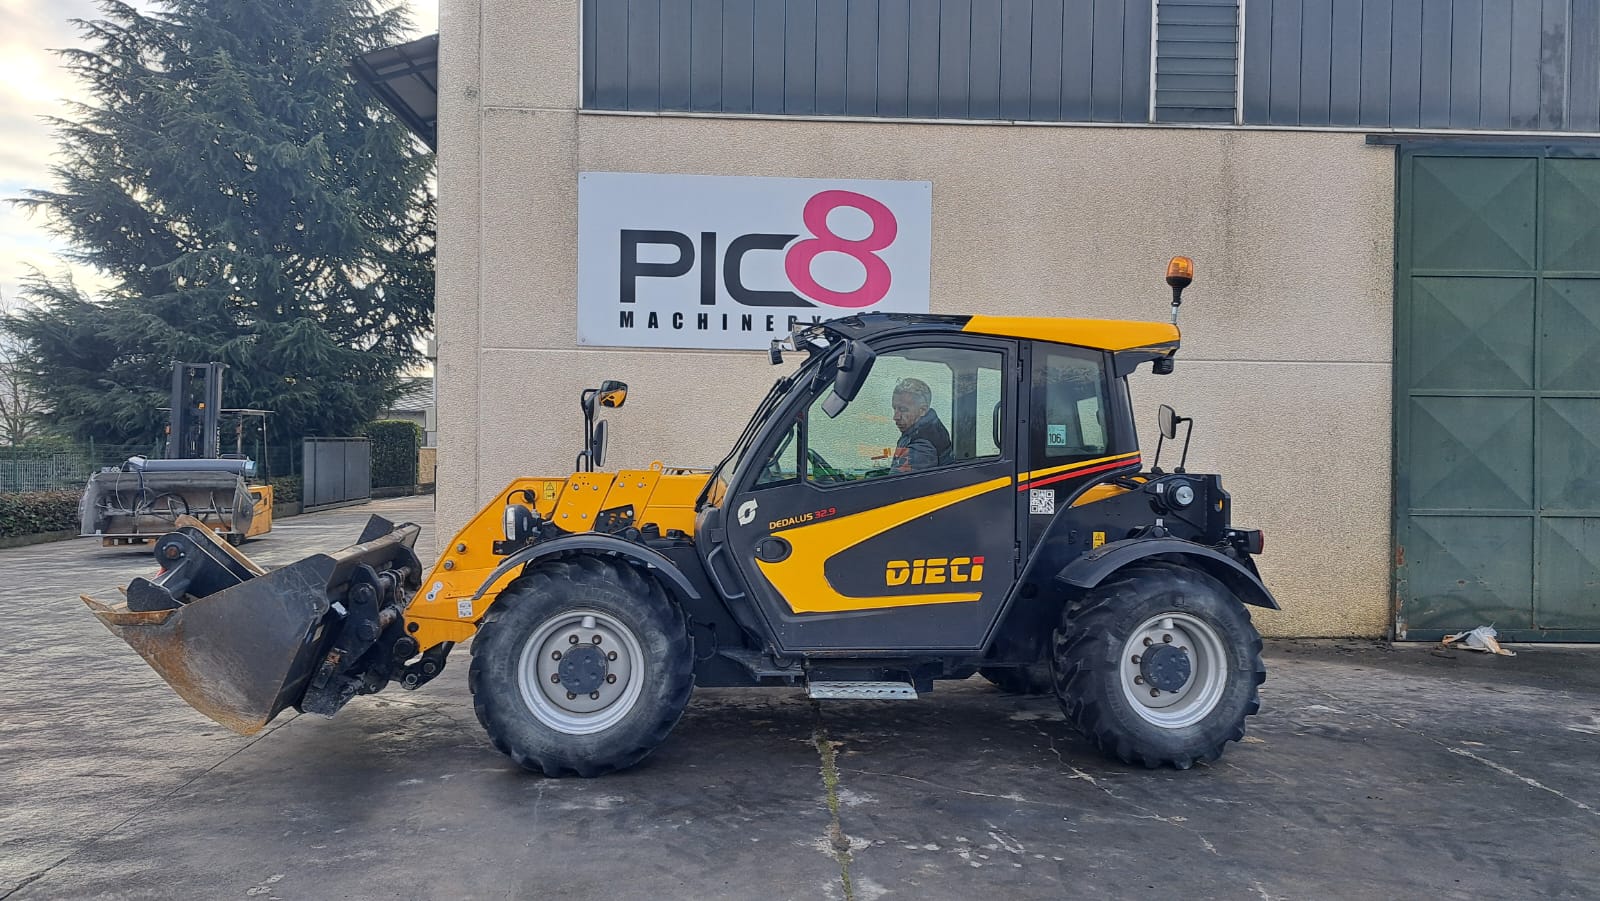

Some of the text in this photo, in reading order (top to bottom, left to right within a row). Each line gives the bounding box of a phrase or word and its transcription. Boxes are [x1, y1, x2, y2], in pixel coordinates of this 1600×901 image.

[619, 189, 898, 308] PIC8
[769, 507, 837, 530] DEDALUS 32.9
